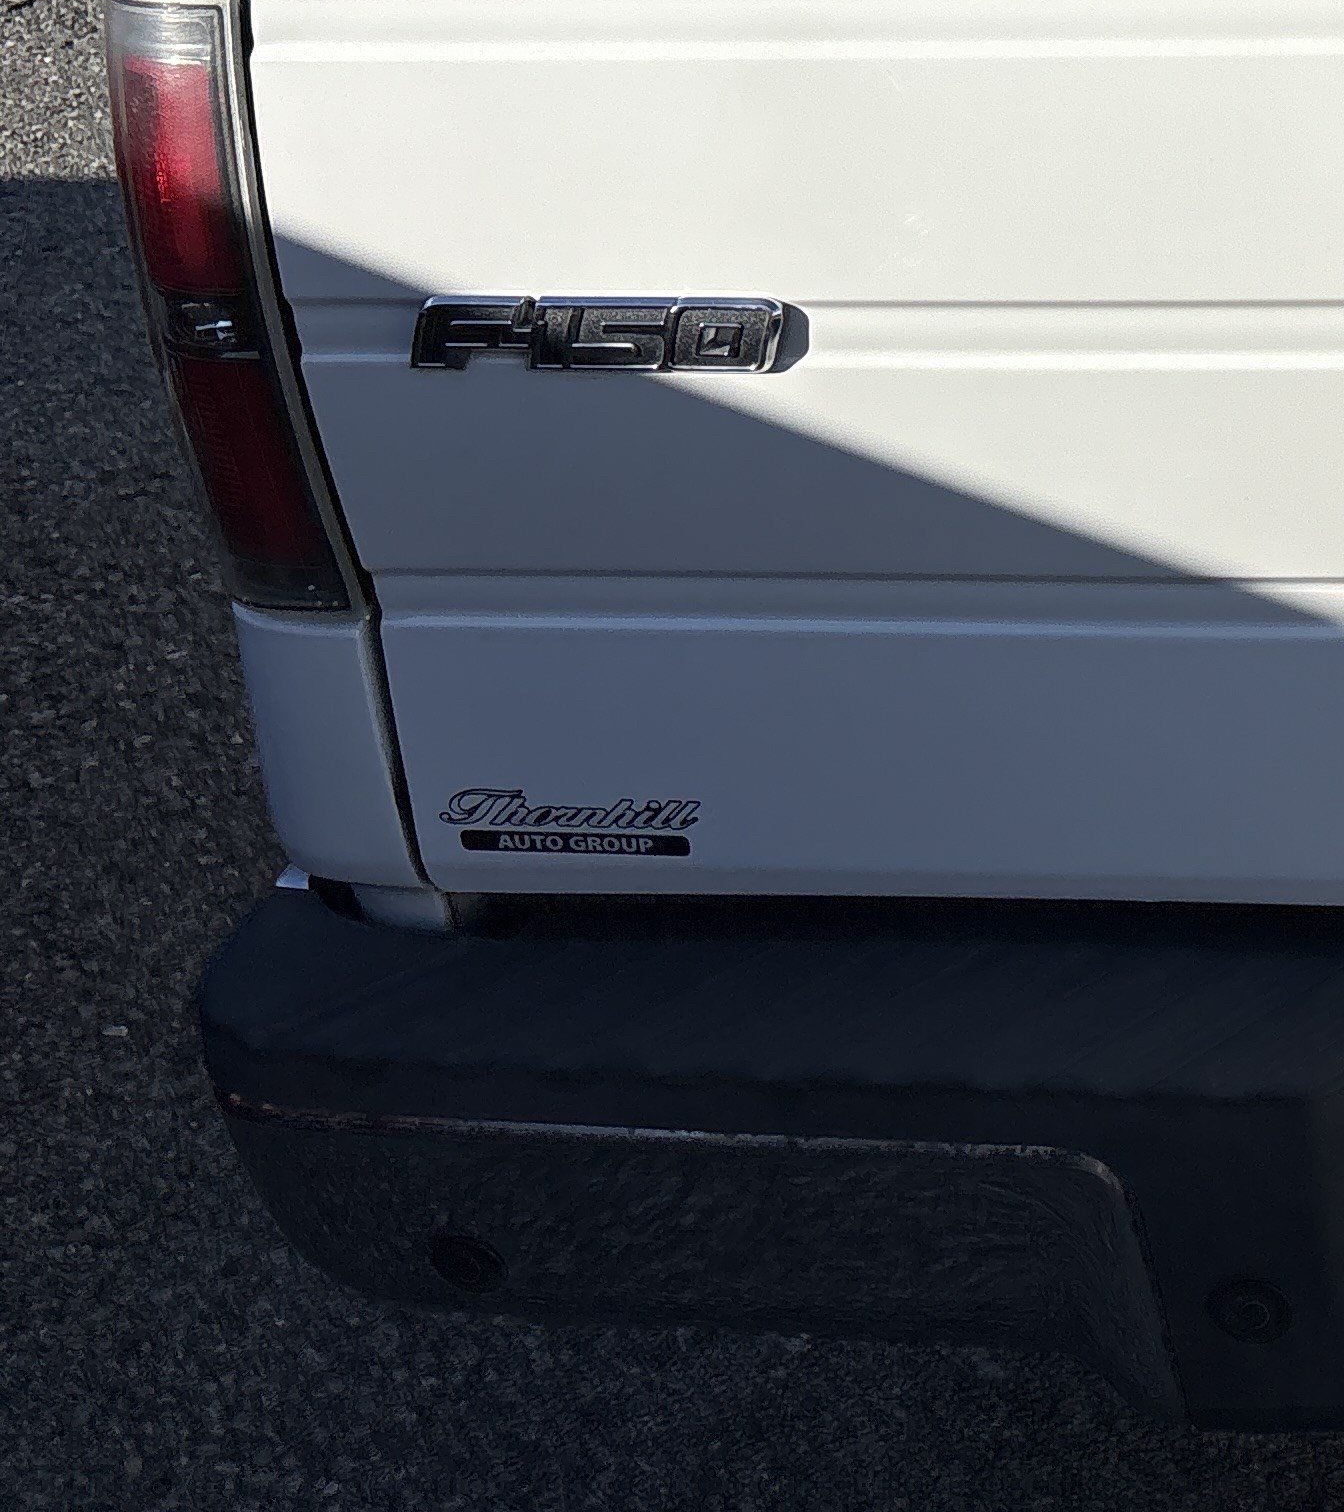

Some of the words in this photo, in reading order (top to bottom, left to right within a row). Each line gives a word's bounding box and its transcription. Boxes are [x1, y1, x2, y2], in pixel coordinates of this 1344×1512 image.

[439, 788, 701, 830] Thornhill
[499, 834, 563, 851] AUTO
[569, 835, 654, 854] GROUP
